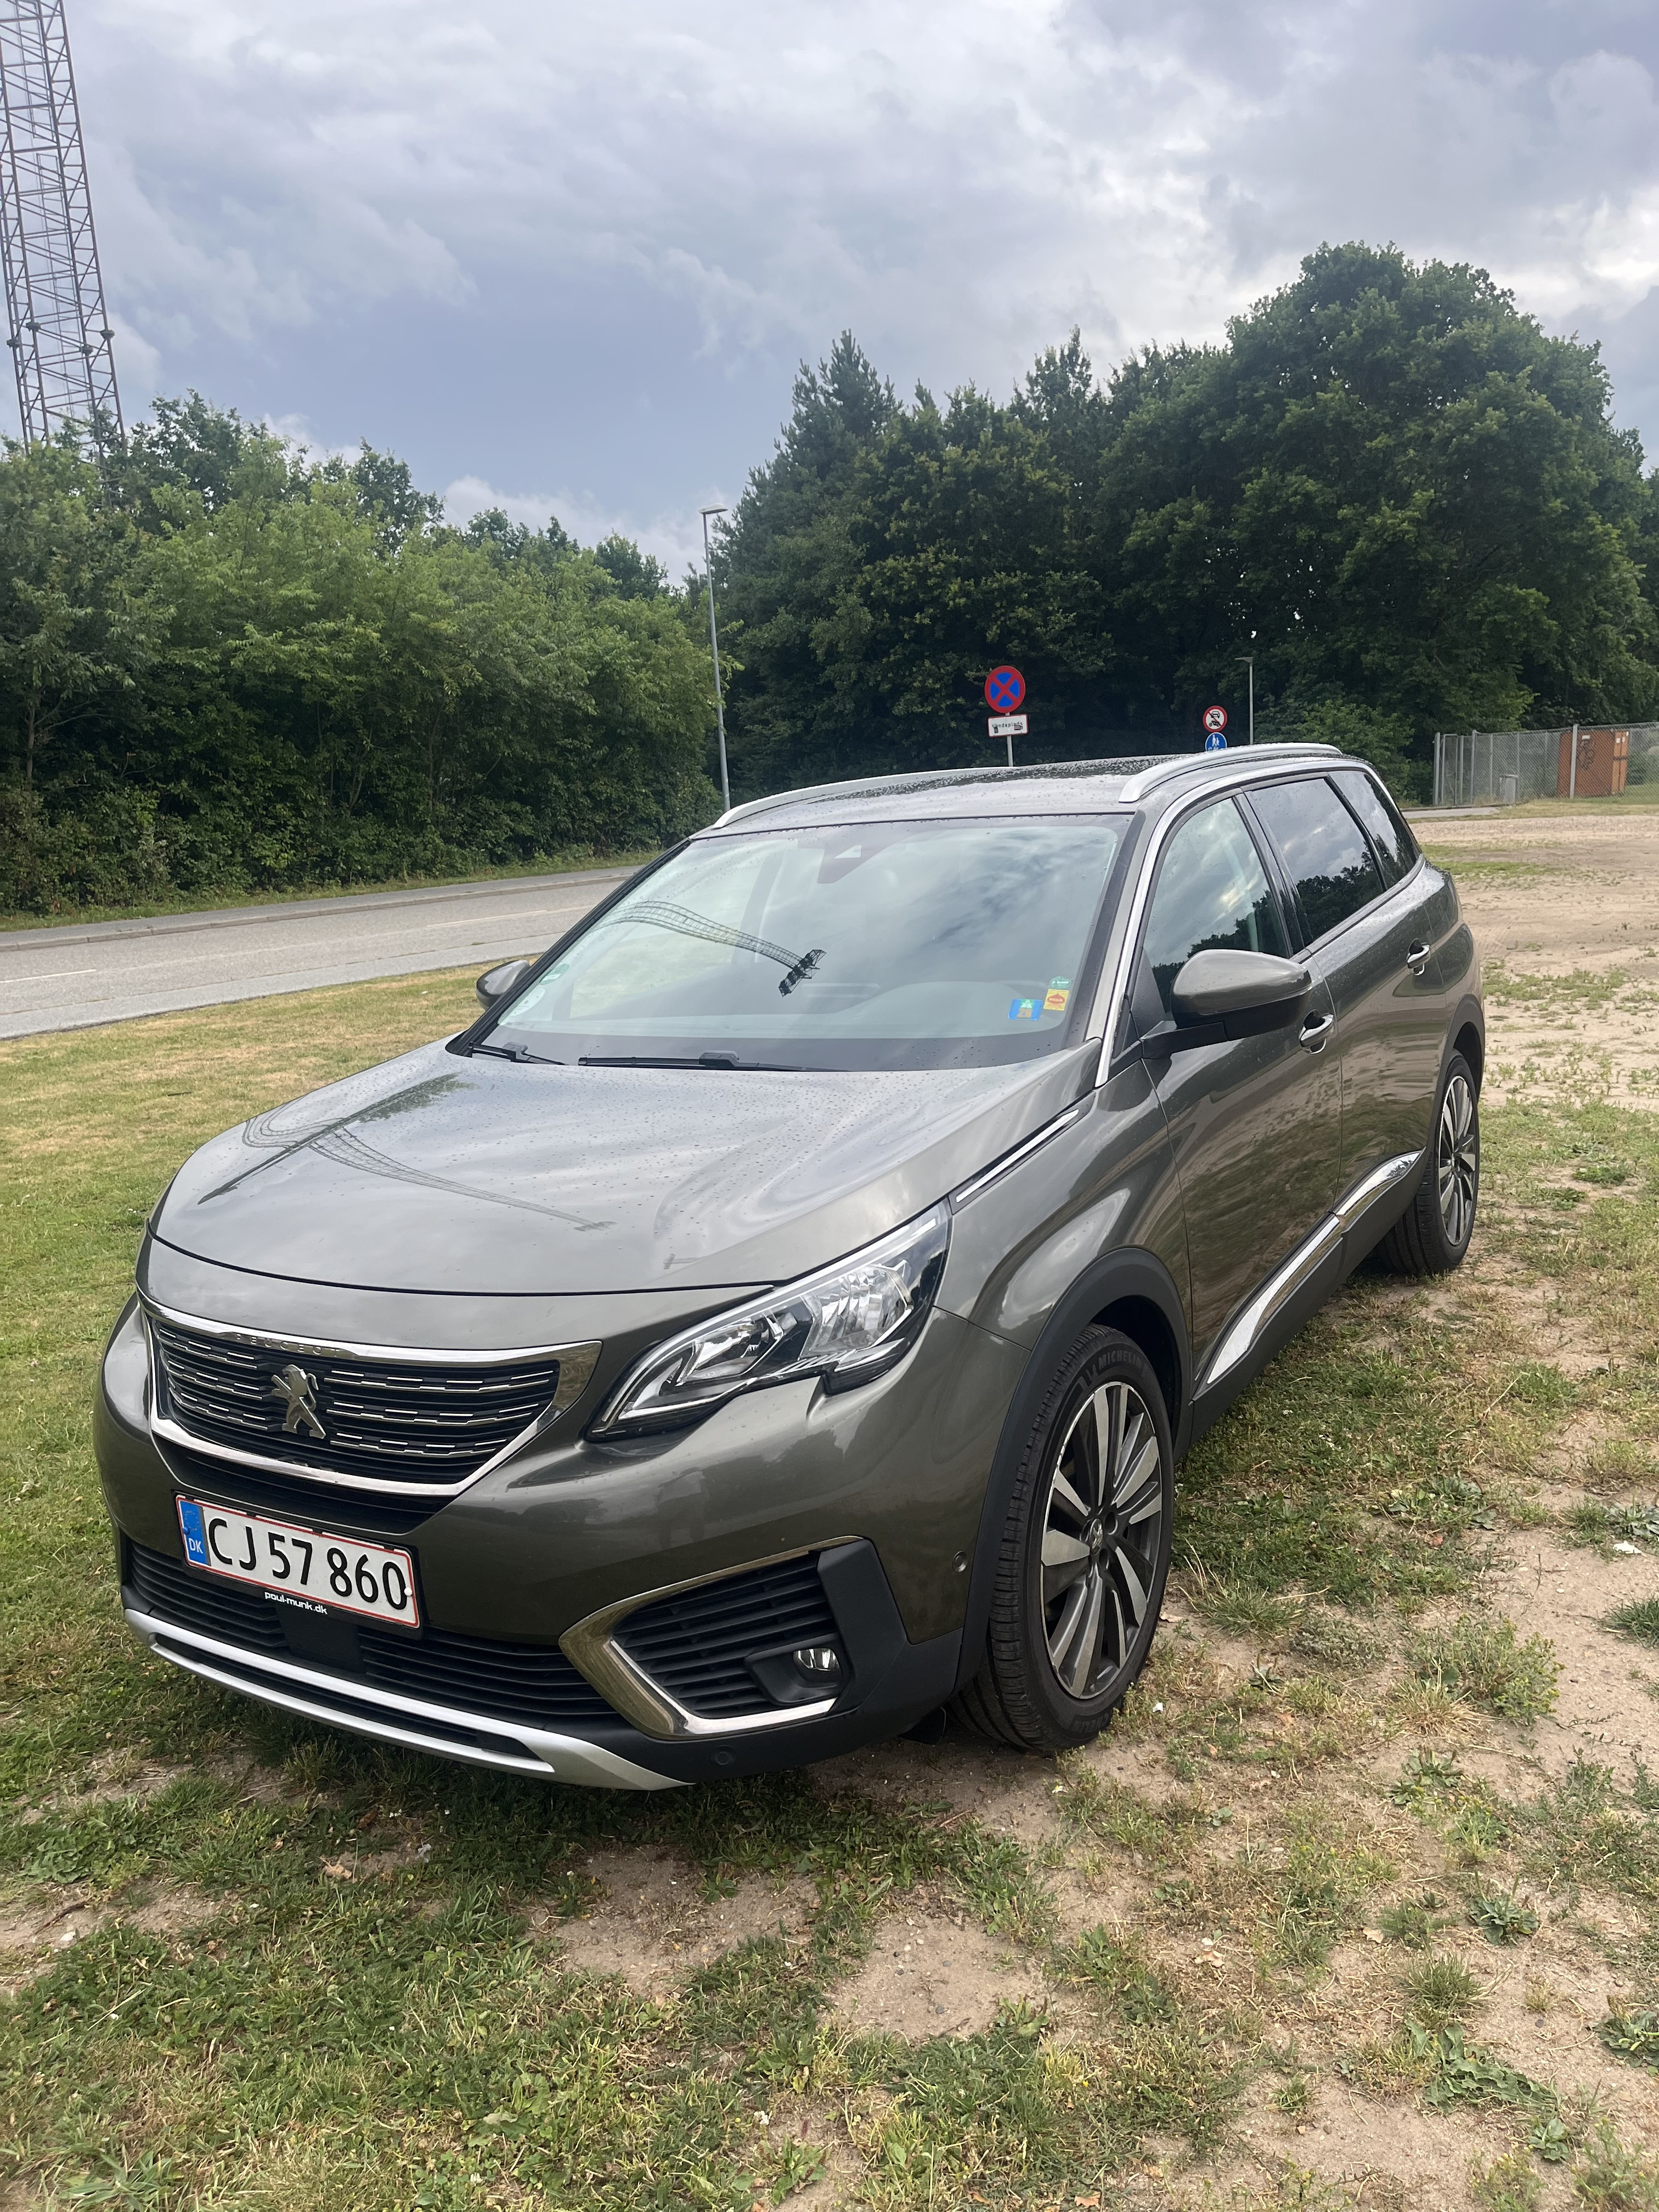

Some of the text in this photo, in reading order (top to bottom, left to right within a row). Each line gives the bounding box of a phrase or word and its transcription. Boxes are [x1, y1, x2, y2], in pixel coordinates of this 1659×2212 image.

[236, 1334, 340, 1357] PEUGEOT
[1098, 1350, 1142, 1370] MICHELIN
[188, 1537, 203, 1554] DK
[208, 1518, 407, 1610] CJ 57 860
[264, 1592, 328, 1615] poul-munk.dk
